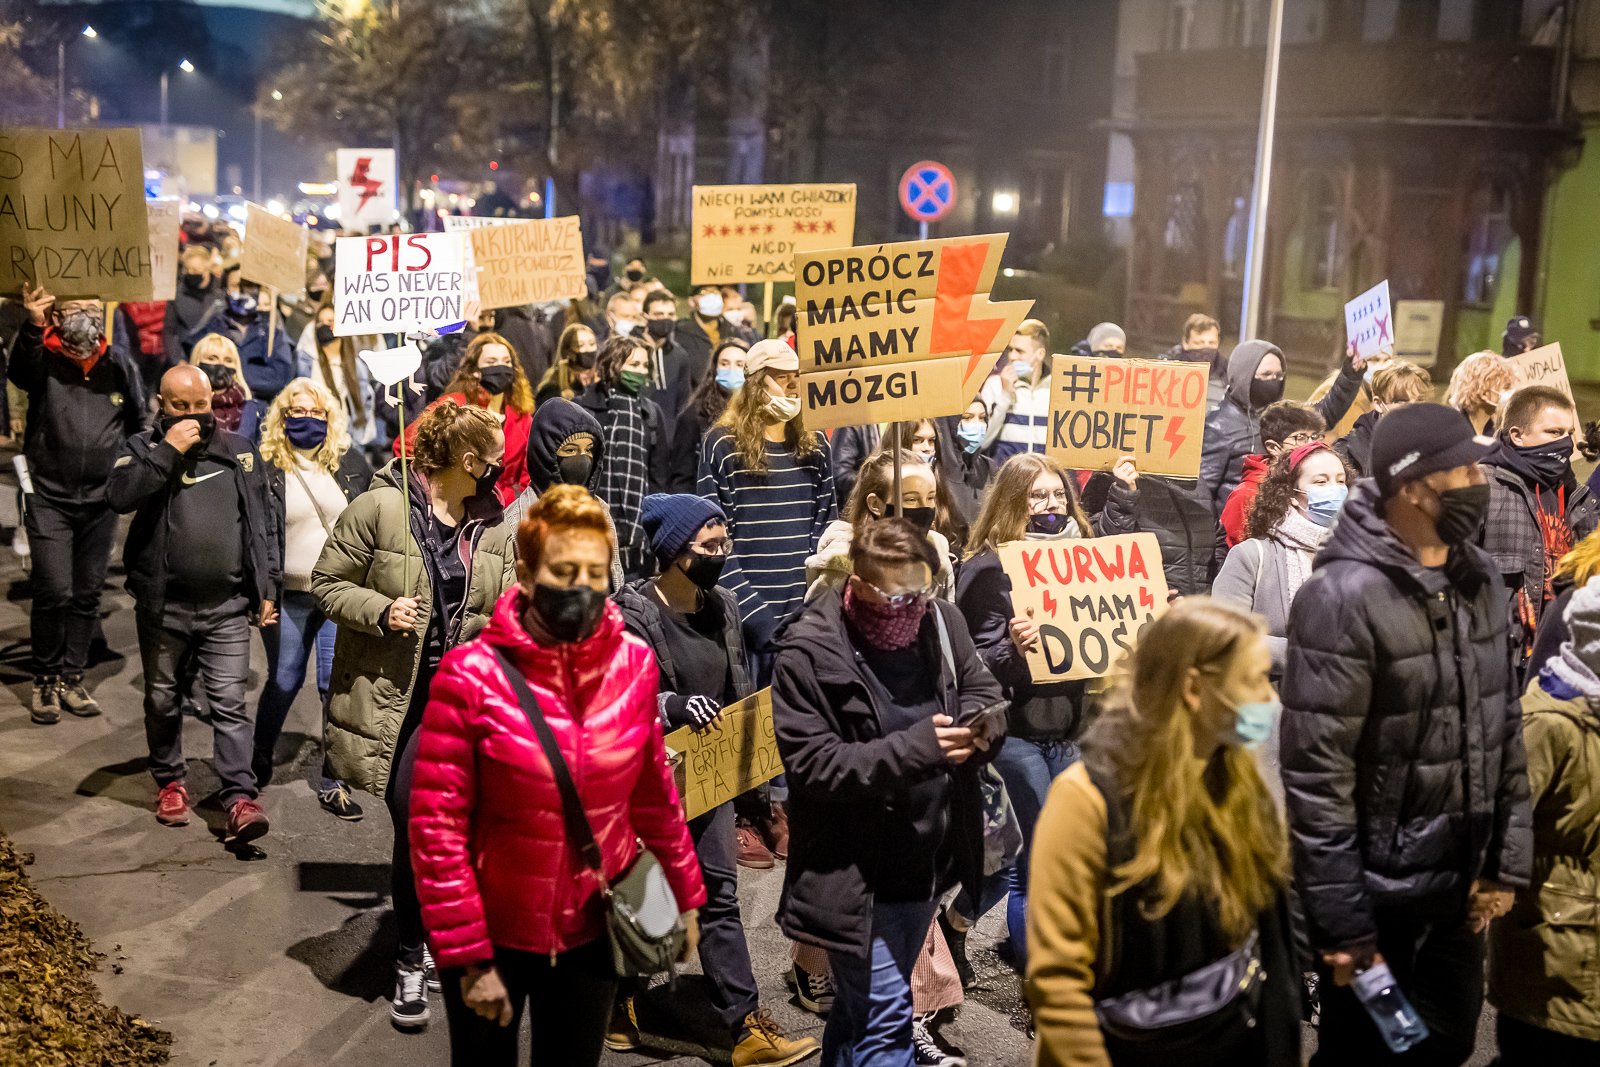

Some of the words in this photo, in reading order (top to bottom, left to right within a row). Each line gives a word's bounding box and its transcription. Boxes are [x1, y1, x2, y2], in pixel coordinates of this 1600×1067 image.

[49, 133, 123, 183] MA
[750, 191, 785, 205] WAM
[10, 245, 152, 283] RYDZYKACH
[366, 234, 432, 272] PIS
[802, 246, 935, 287] OPRÓCZ
[344, 272, 390, 296] WAS
[398, 272, 462, 293] NEVER
[341, 299, 372, 324] AN
[381, 295, 461, 322] OPTION
[806, 288, 917, 327] MACIC
[813, 326, 920, 366] MAMY
[807, 370, 919, 410] MÓZGI
[1062, 364, 1205, 409] #PIEKŁO
[1052, 410, 1163, 453] KOBIET
[1022, 541, 1149, 588] KURWA
[1069, 594, 1137, 622] MAM
[696, 769, 730, 807] TA
